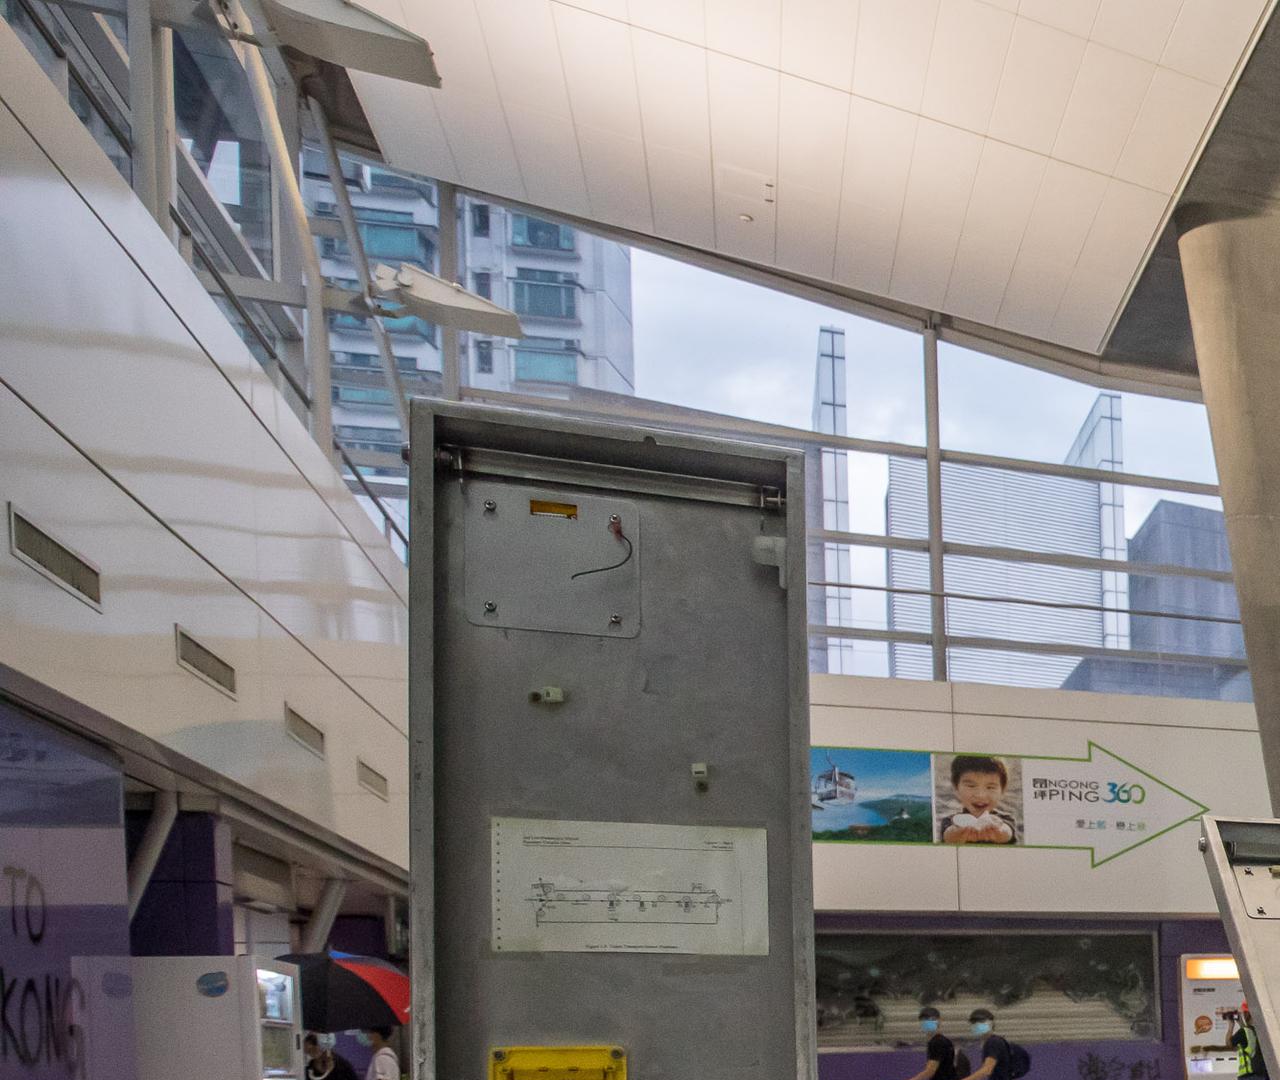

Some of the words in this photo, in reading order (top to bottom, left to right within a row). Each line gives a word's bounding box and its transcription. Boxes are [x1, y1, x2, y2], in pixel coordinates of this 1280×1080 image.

[1048, 779, 1099, 790] NGONG
[1102, 782, 1146, 804] 360
[1049, 789, 1100, 803] PING
[3, 865, 46, 944] TO
